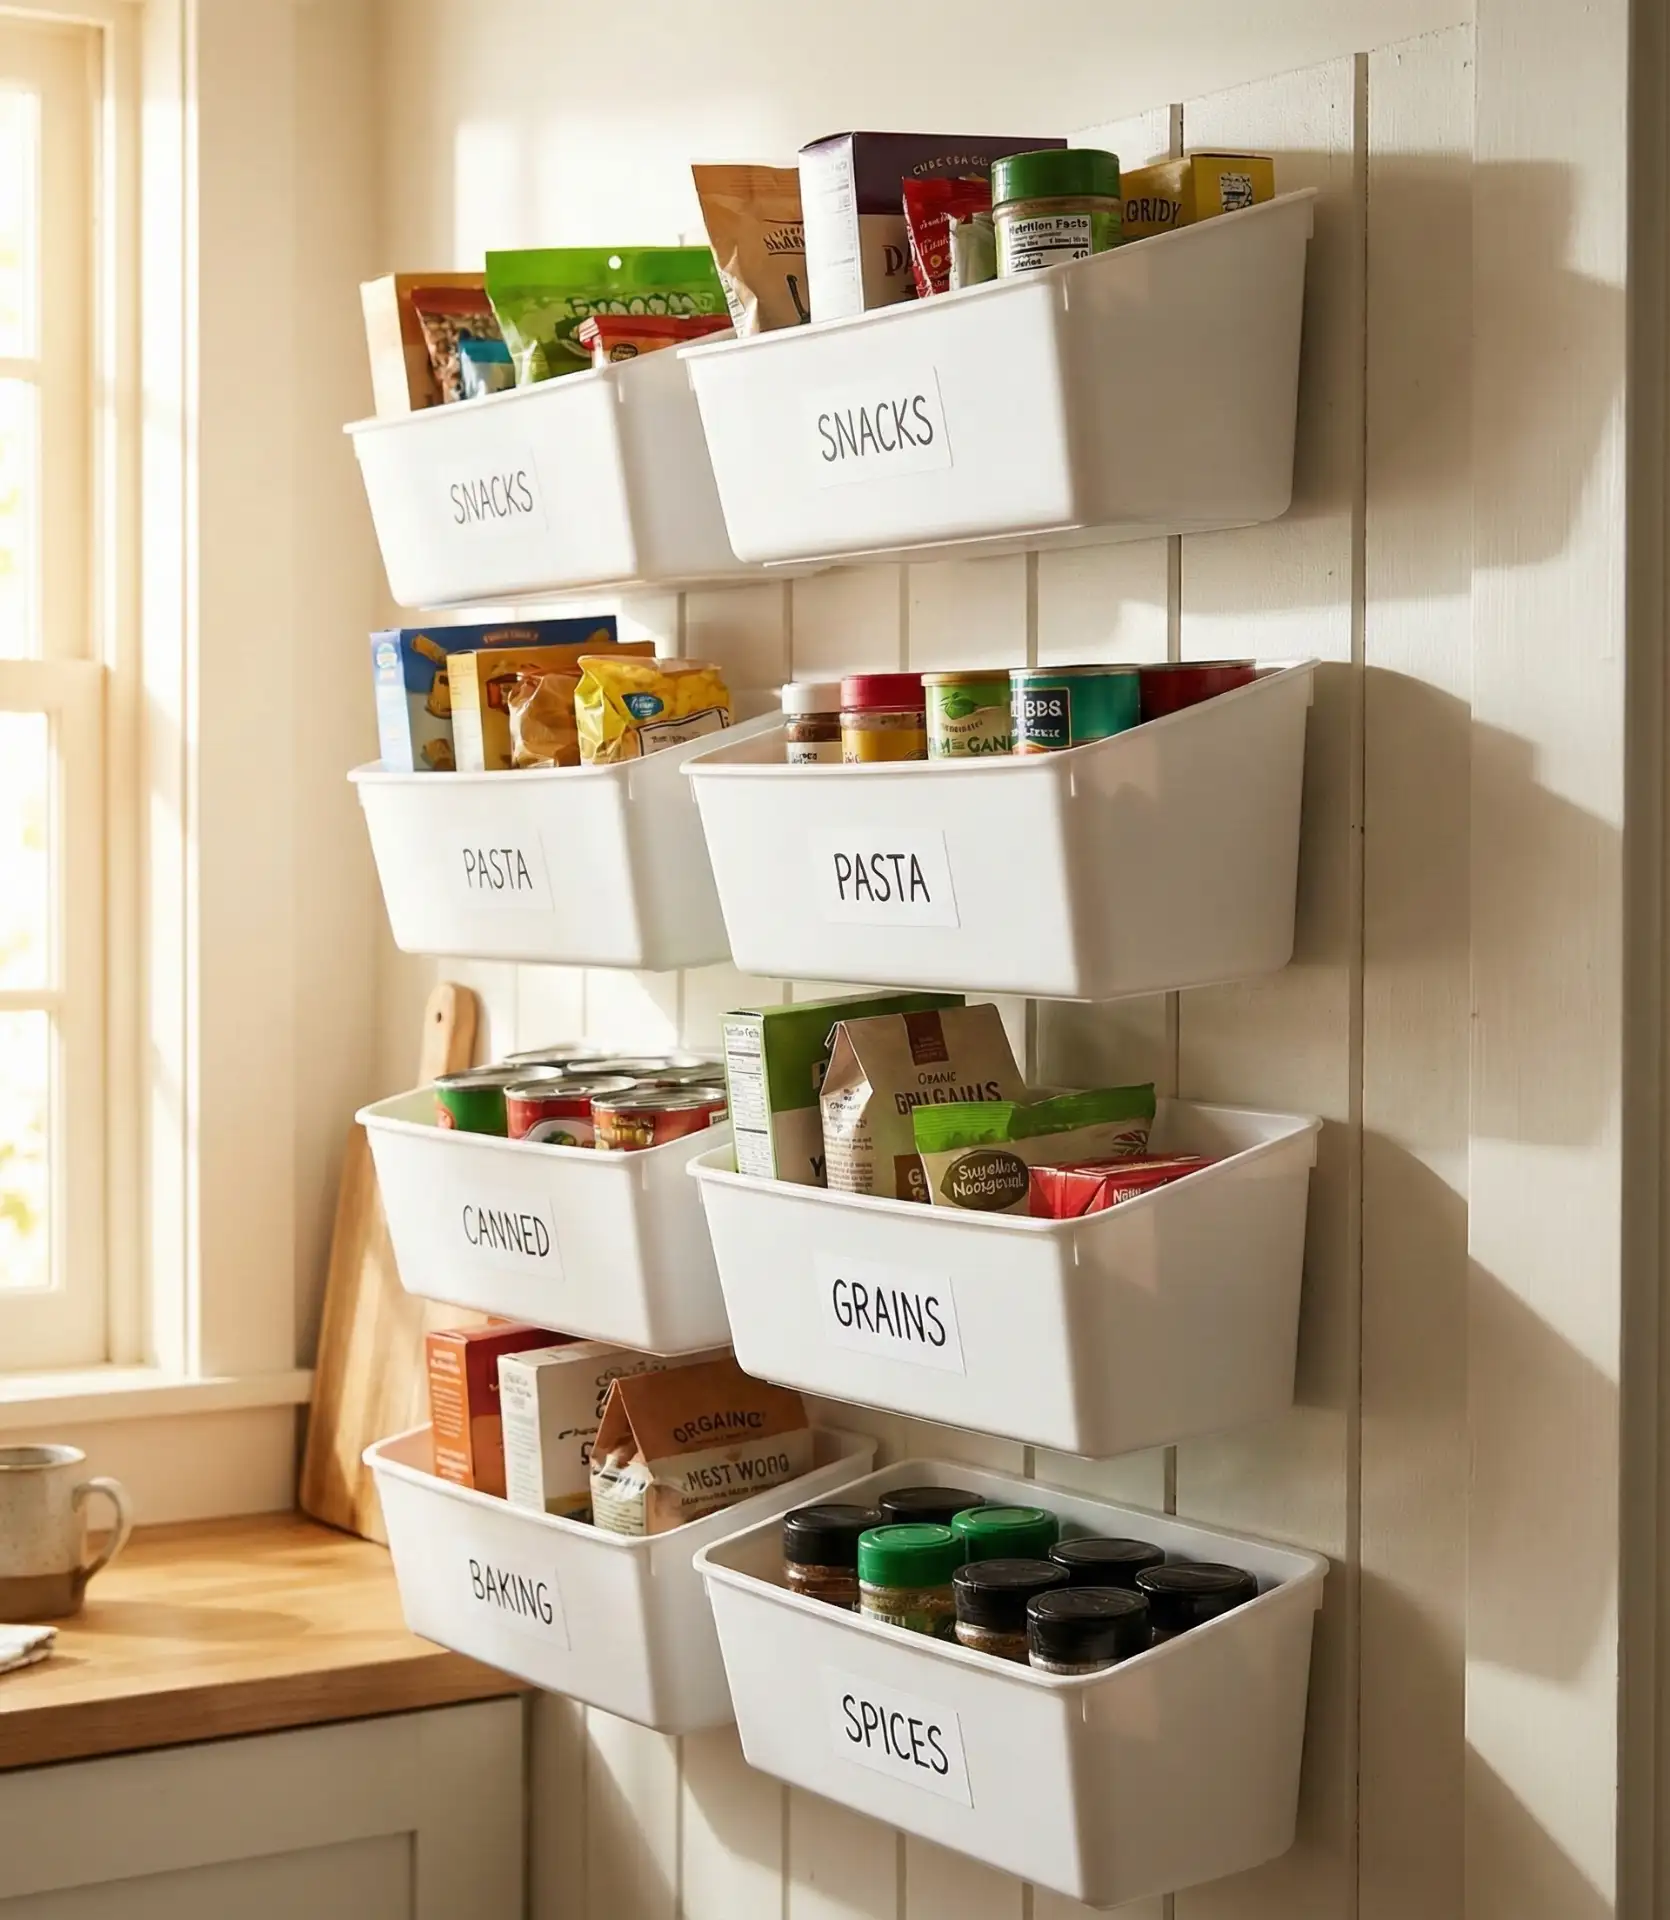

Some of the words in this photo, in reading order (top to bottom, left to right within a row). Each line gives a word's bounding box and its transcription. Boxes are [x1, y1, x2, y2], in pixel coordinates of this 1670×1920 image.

[817, 395, 934, 462] SNACKS
[450, 470, 534, 524] SNACKS
[463, 848, 533, 890] PASTA
[833, 852, 931, 903] PASTA
[463, 1204, 550, 1257] CANNED
[832, 1278, 946, 1347] GRAINS
[469, 1558, 553, 1625] BAKING
[842, 1694, 949, 1775] SPICES
